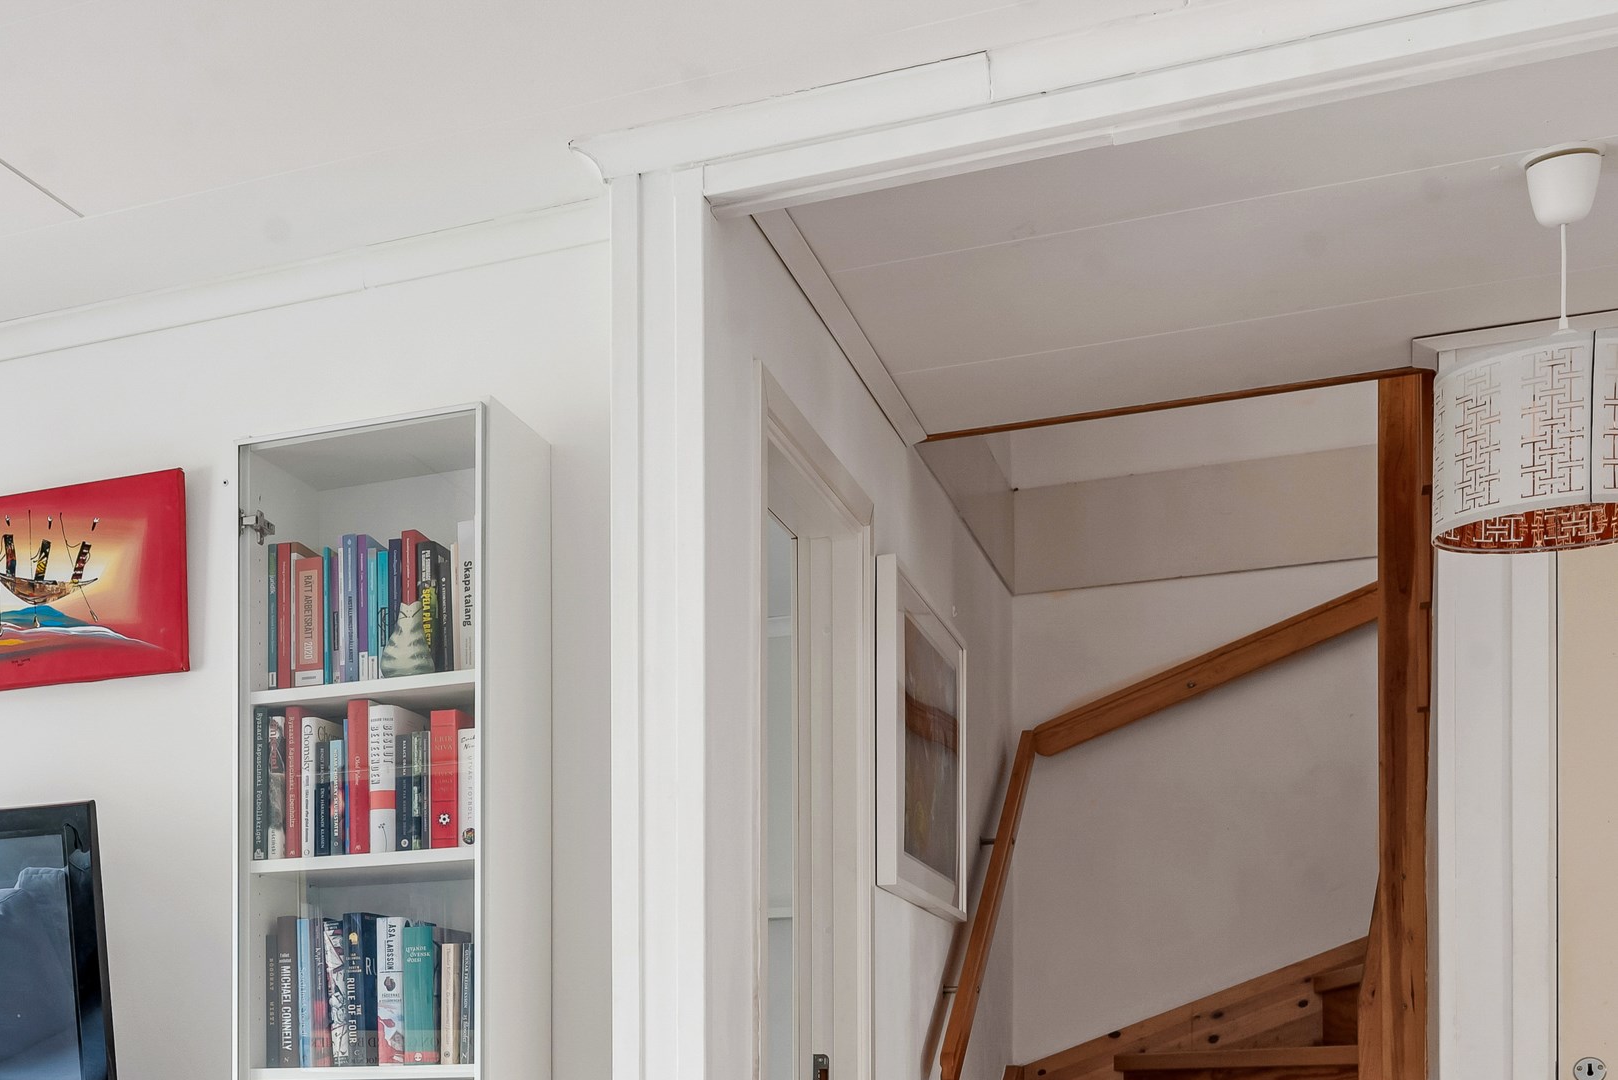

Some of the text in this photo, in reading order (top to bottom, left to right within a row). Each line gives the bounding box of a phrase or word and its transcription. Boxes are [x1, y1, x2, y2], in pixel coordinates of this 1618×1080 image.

[463, 561, 472, 592] Skapa
[422, 589, 430, 610] SPELA
[463, 595, 472, 627] talang
[303, 575, 313, 659] RÄTT ARBETSRÄTT 2020
[303, 725, 313, 771] Chomsky
[387, 924, 396, 970] ÅSA LARSSON
[347, 977, 356, 1000] RULE
[282, 965, 291, 1051] MICHAEL CONNELLY
[347, 1004, 356, 1015] OF
[347, 1019, 356, 1043] FOUR
